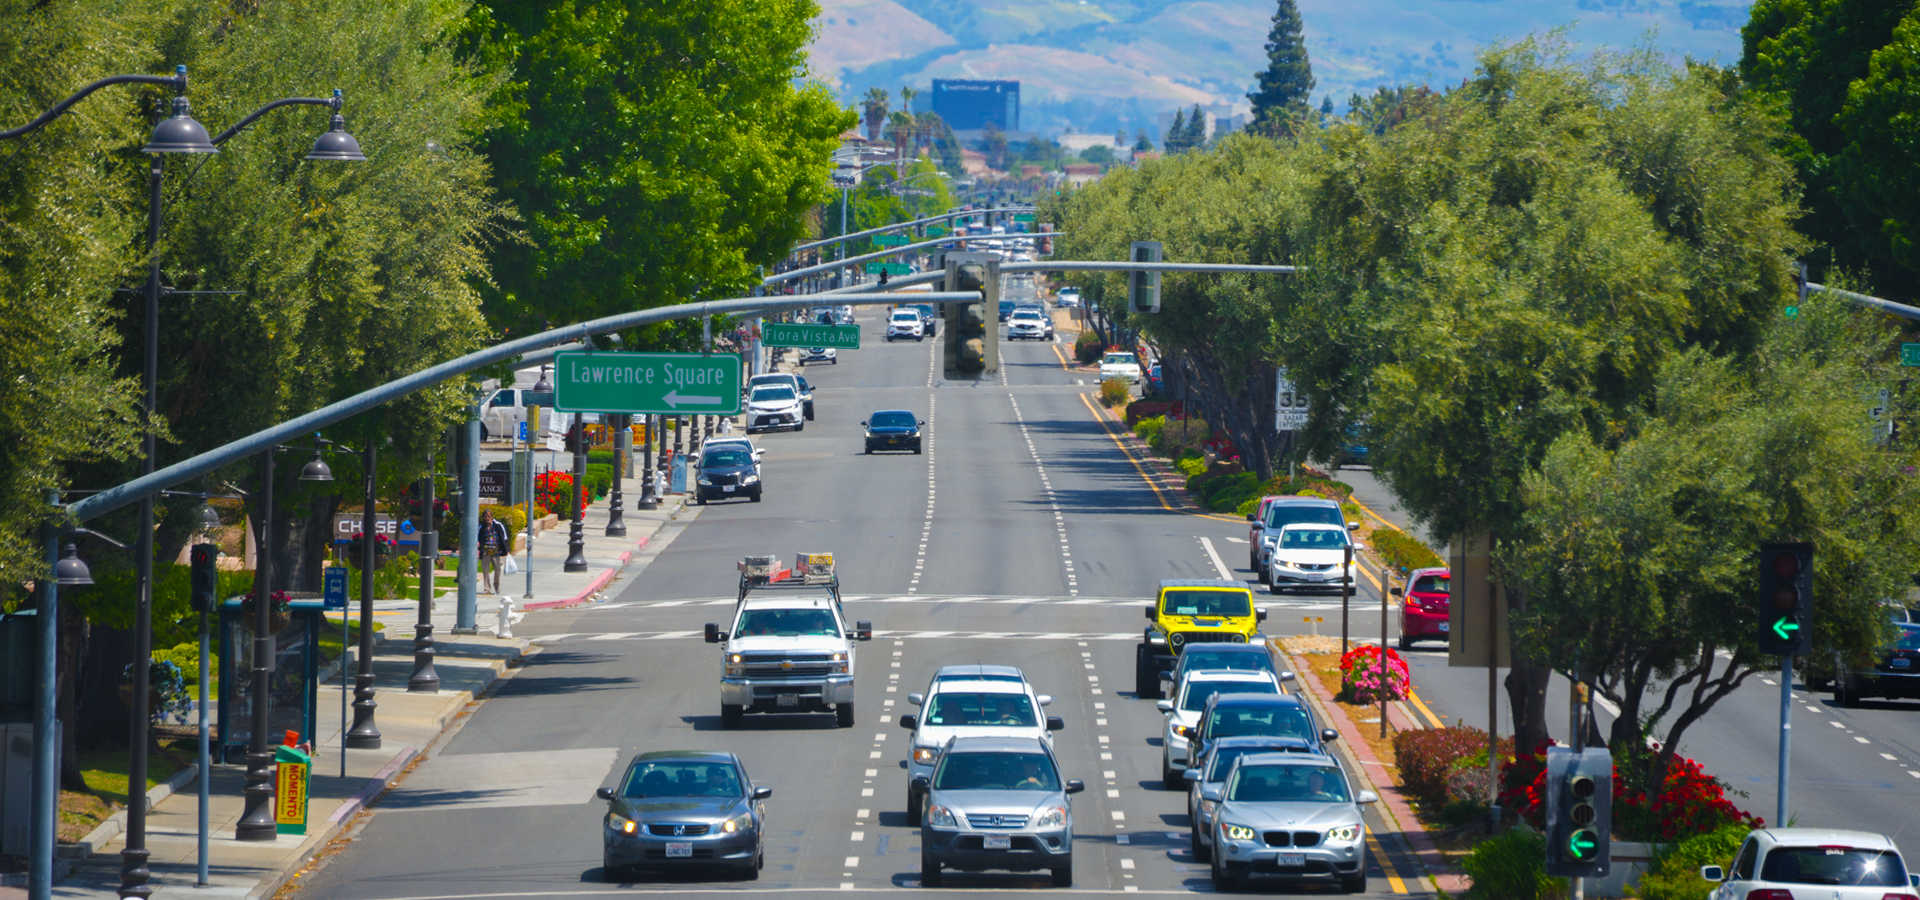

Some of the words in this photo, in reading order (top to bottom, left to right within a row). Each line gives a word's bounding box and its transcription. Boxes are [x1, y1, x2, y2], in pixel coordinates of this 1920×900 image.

[765, 328, 799, 342] Flora
[801, 328, 836, 343] Vista
[838, 331, 857, 344] Ave
[571, 361, 655, 385] Lawrence
[663, 361, 725, 390] Square
[338, 520, 398, 534] CHSE
[286, 764, 300, 818] MOMENTO
